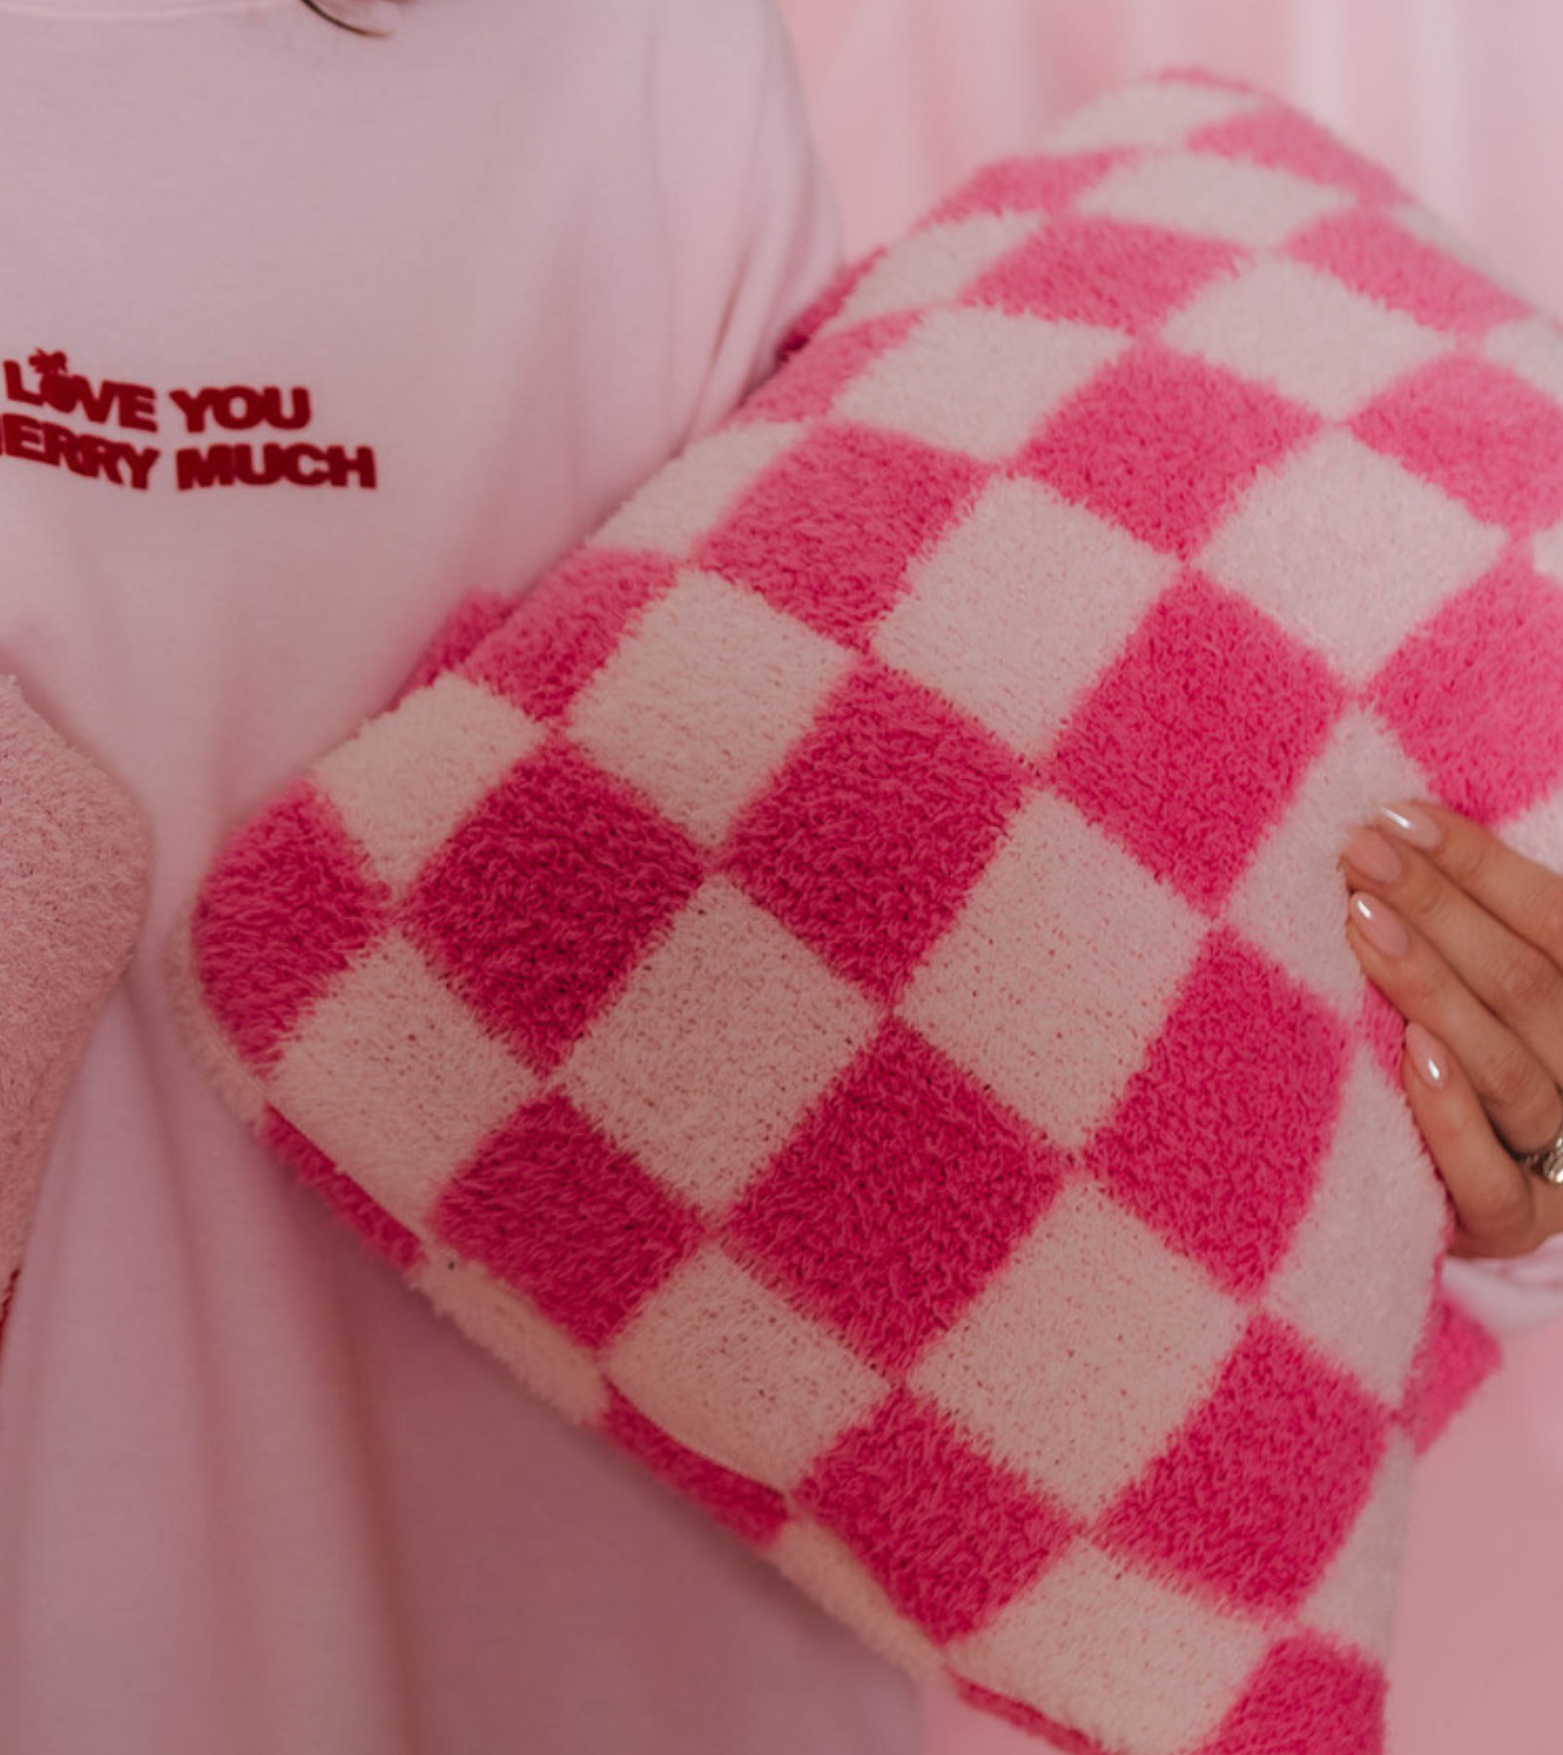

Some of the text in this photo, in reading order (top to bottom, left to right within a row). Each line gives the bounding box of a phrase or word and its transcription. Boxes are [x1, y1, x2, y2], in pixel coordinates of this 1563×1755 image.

[3, 350, 158, 433] LOVE
[169, 385, 312, 434] YOU
[176, 442, 378, 491] MUCH
